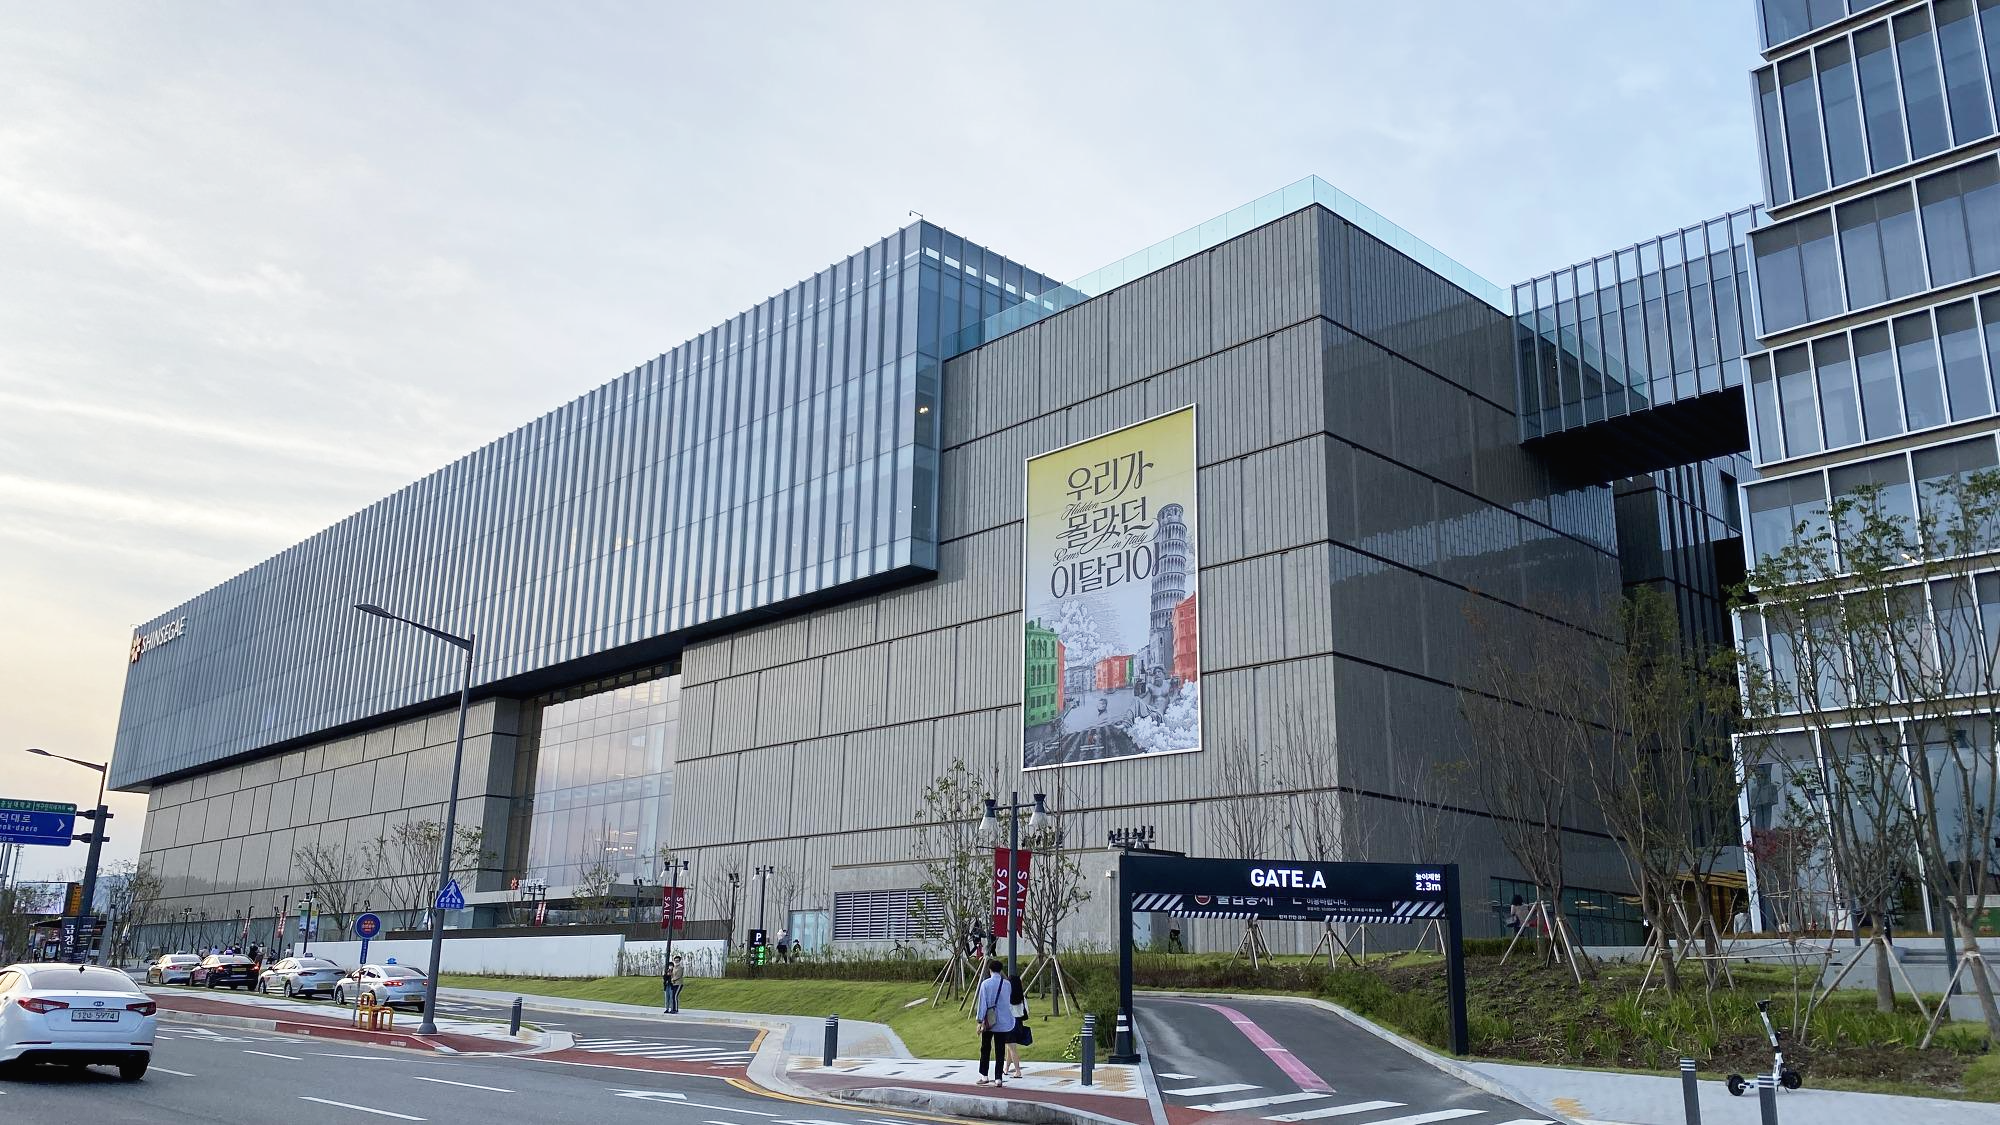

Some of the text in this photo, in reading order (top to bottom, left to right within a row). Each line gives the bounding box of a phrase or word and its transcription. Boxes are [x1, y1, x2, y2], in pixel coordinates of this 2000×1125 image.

[1066, 450, 1154, 504] 우리가
[1061, 500, 1099, 520] Hidden
[1056, 496, 1154, 554] 몰랐던
[1053, 548, 1080, 567] Gems
[1121, 532, 1148, 550] Italy
[1051, 542, 1168, 599] 이탈리아
[141, 616, 187, 654] SHINSEGAE
[996, 868, 1008, 916] SALE
[1250, 868, 1327, 889] GATE.A
[1415, 881, 1442, 891] 2.3m
[663, 896, 671, 919] SALE
[675, 896, 684, 920] SALE
[755, 932, 762, 941] P
